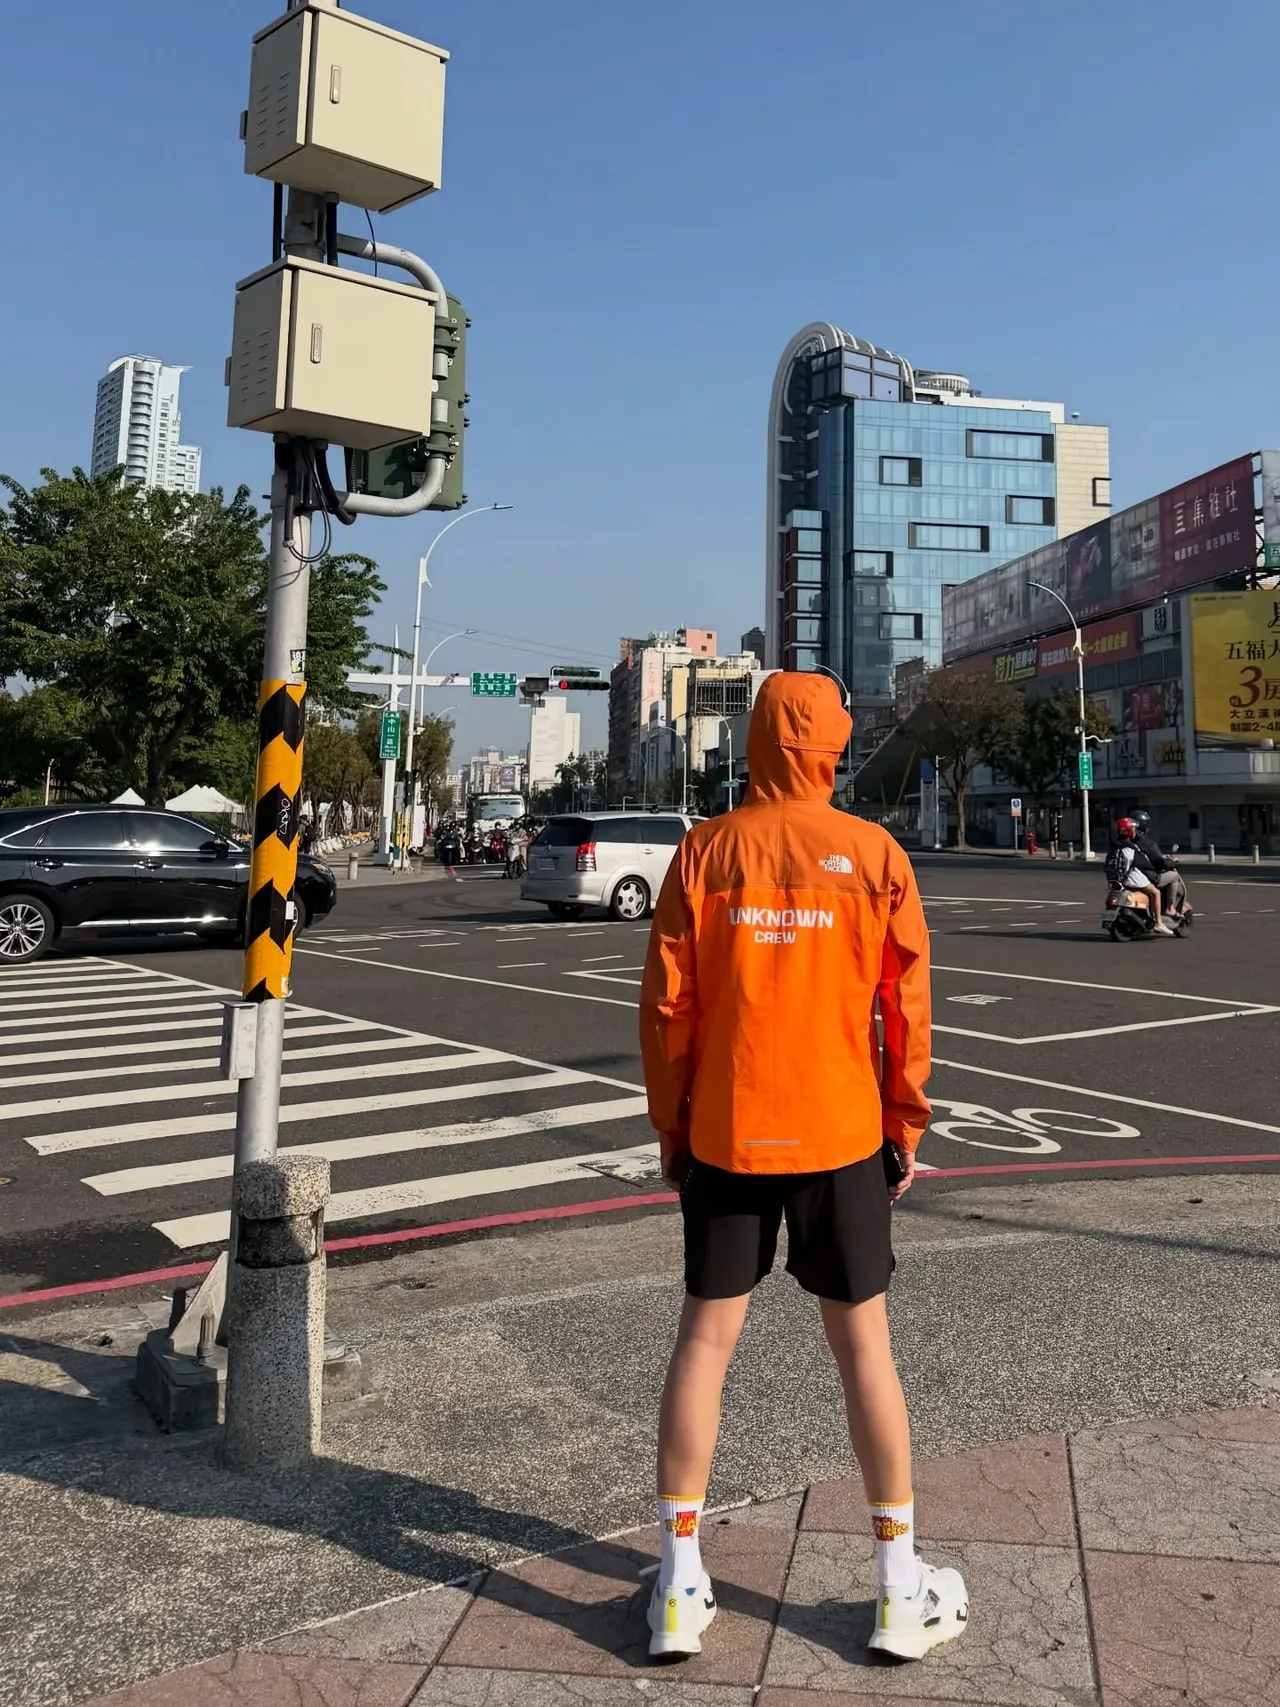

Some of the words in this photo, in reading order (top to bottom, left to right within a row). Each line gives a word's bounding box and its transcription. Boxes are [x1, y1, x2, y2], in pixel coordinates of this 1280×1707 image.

[818, 859, 842, 867] NORTH
[824, 865, 842, 873] FACE
[729, 906, 834, 929] UNKNOWN
[754, 930, 797, 944] CREW
